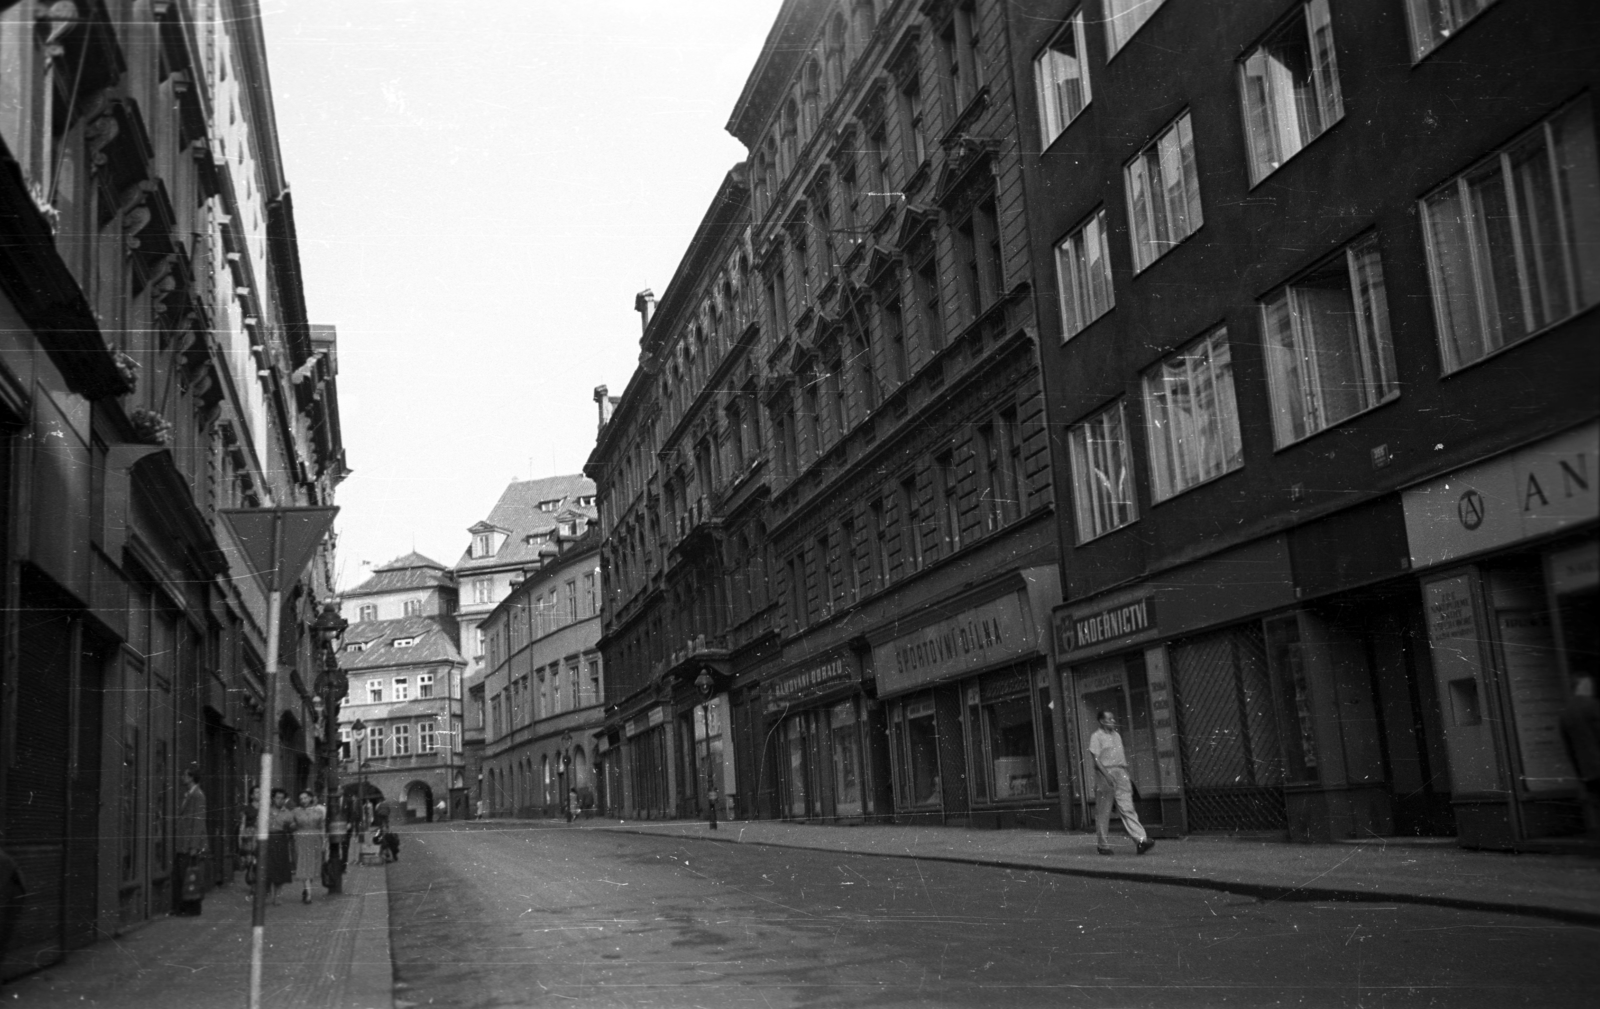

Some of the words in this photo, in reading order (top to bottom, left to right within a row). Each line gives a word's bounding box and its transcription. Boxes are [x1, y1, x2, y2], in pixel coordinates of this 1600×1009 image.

[1524, 453, 1590, 512] AN
[896, 628, 959, 674] SPORTOVNÍ
[960, 617, 1002, 654] DÍLNA
[1076, 598, 1148, 647] KADEŘNICTVÍ
